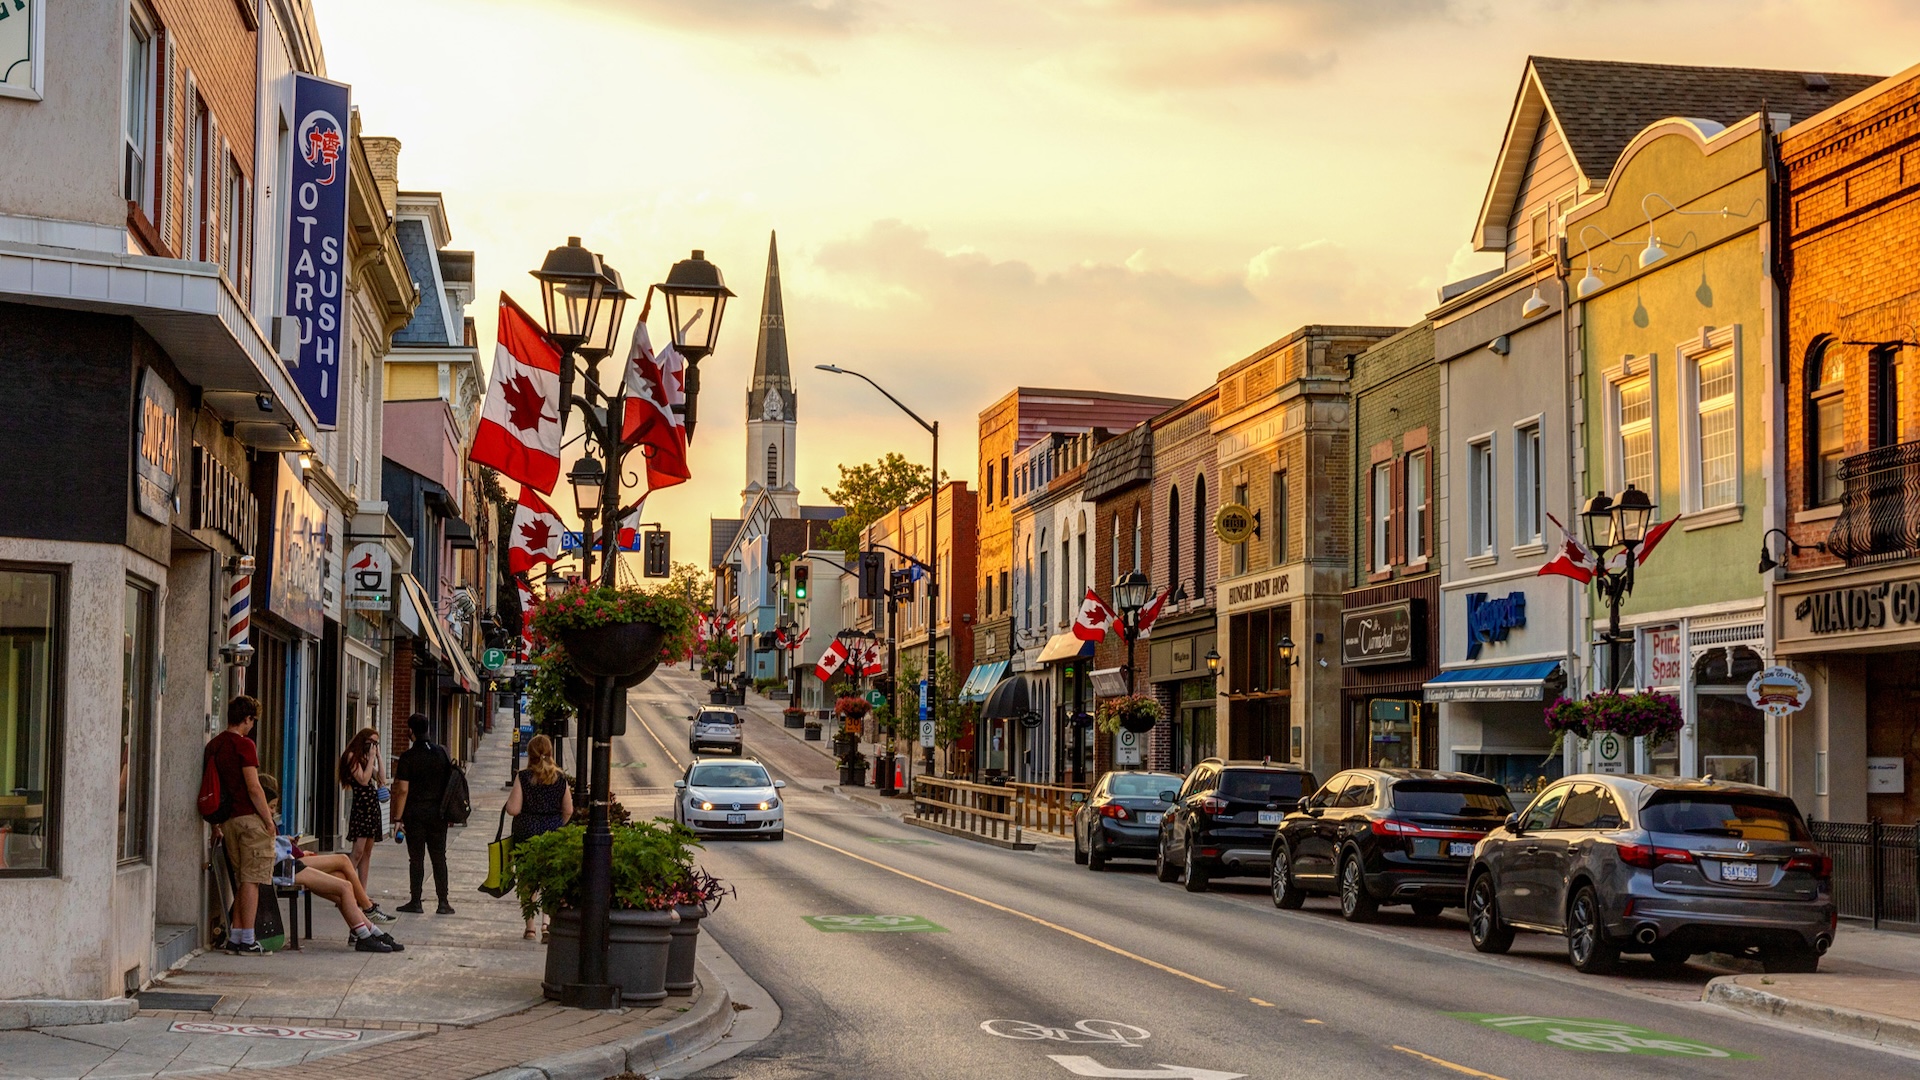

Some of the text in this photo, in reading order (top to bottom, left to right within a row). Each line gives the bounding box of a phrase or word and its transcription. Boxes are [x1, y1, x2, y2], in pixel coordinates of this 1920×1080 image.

[294, 181, 319, 345] OTARU
[315, 236, 339, 398] SUSHI
[1229, 574, 1289, 605] HUNGRY BREW HOPS
[1653, 633, 1680, 656] Prime
[489, 650, 499, 662] P
[871, 691, 881, 703] P
[1125, 734, 1132, 742] P
[1606, 741, 1614, 754] P
